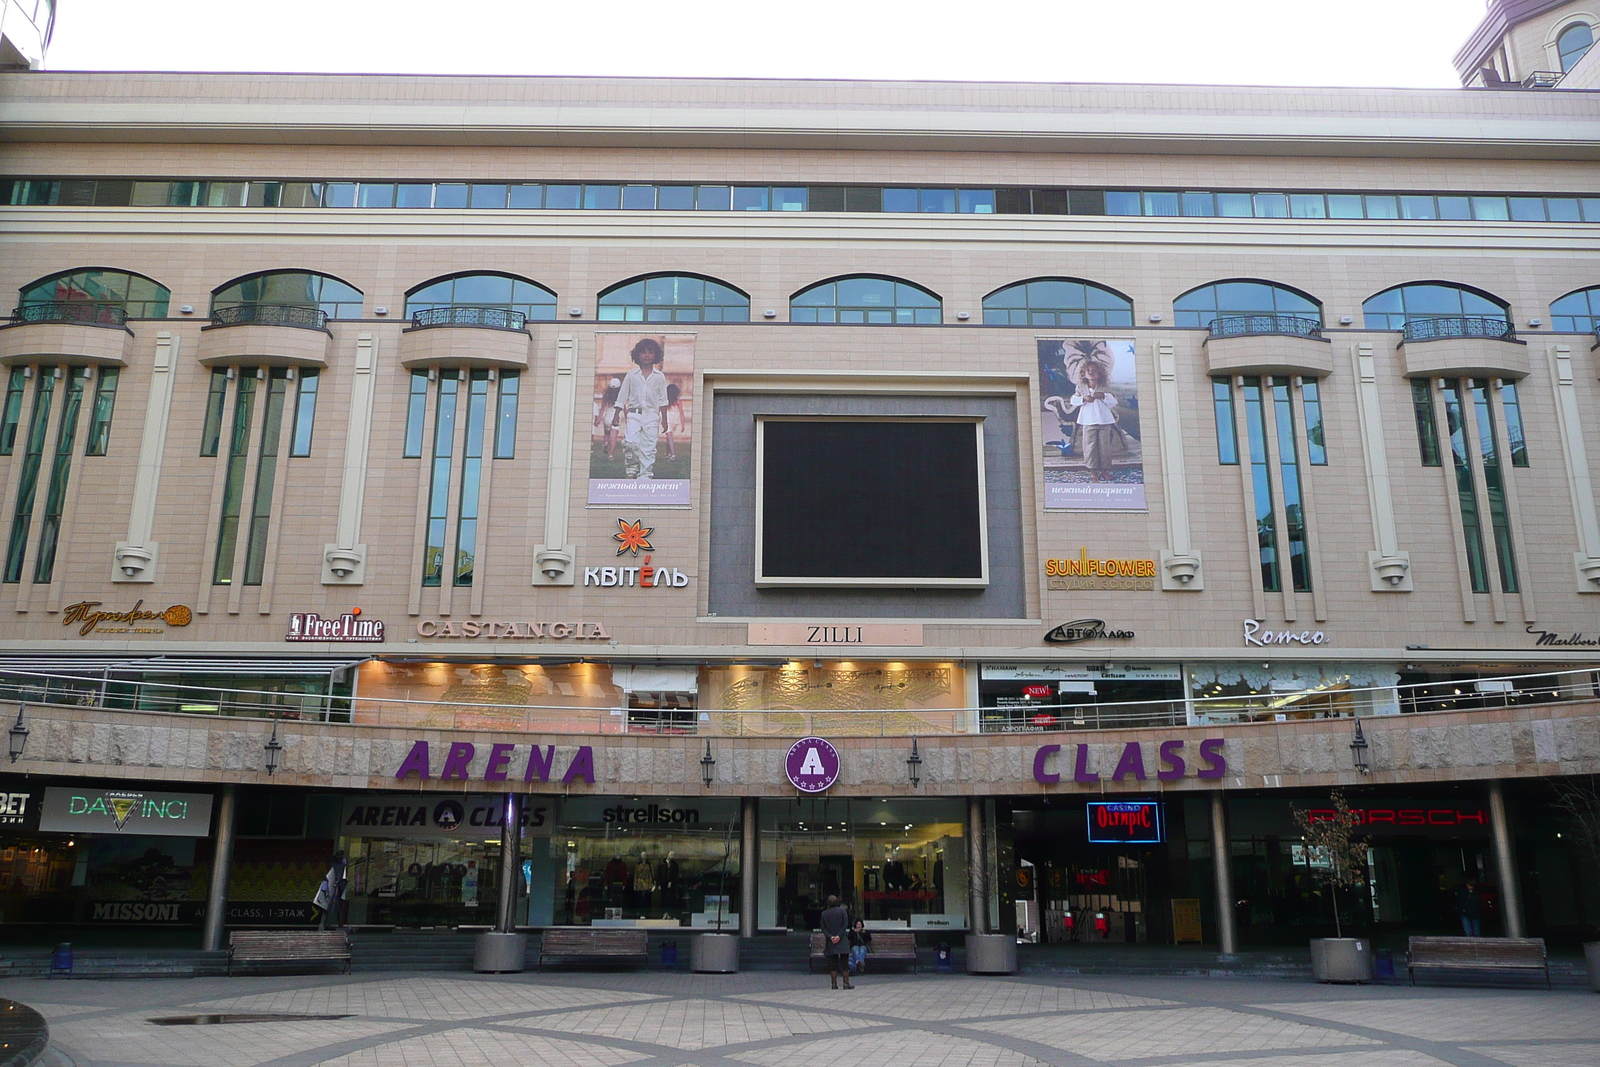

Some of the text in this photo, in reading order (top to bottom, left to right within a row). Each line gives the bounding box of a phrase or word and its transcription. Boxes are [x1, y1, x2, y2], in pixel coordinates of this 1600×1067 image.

[597, 482, 637, 490] нежный
[1051, 486, 1091, 494] нежный
[1050, 579, 1153, 590] студия загара
[303, 607, 384, 637] FreeTime
[416, 620, 611, 640] CASTANGIA
[806, 626, 863, 643] ZILLI
[1526, 626, 1597, 645] Marlboro
[1028, 685, 1050, 695] NEW!
[396, 740, 595, 783] ARENA
[800, 747, 825, 775] A
[1033, 739, 1226, 784] CLASS
[345, 806, 427, 826] ARENA
[602, 804, 700, 823] strellson
[1307, 809, 1490, 825] PORSCH
[92, 903, 181, 921] MISSONI
